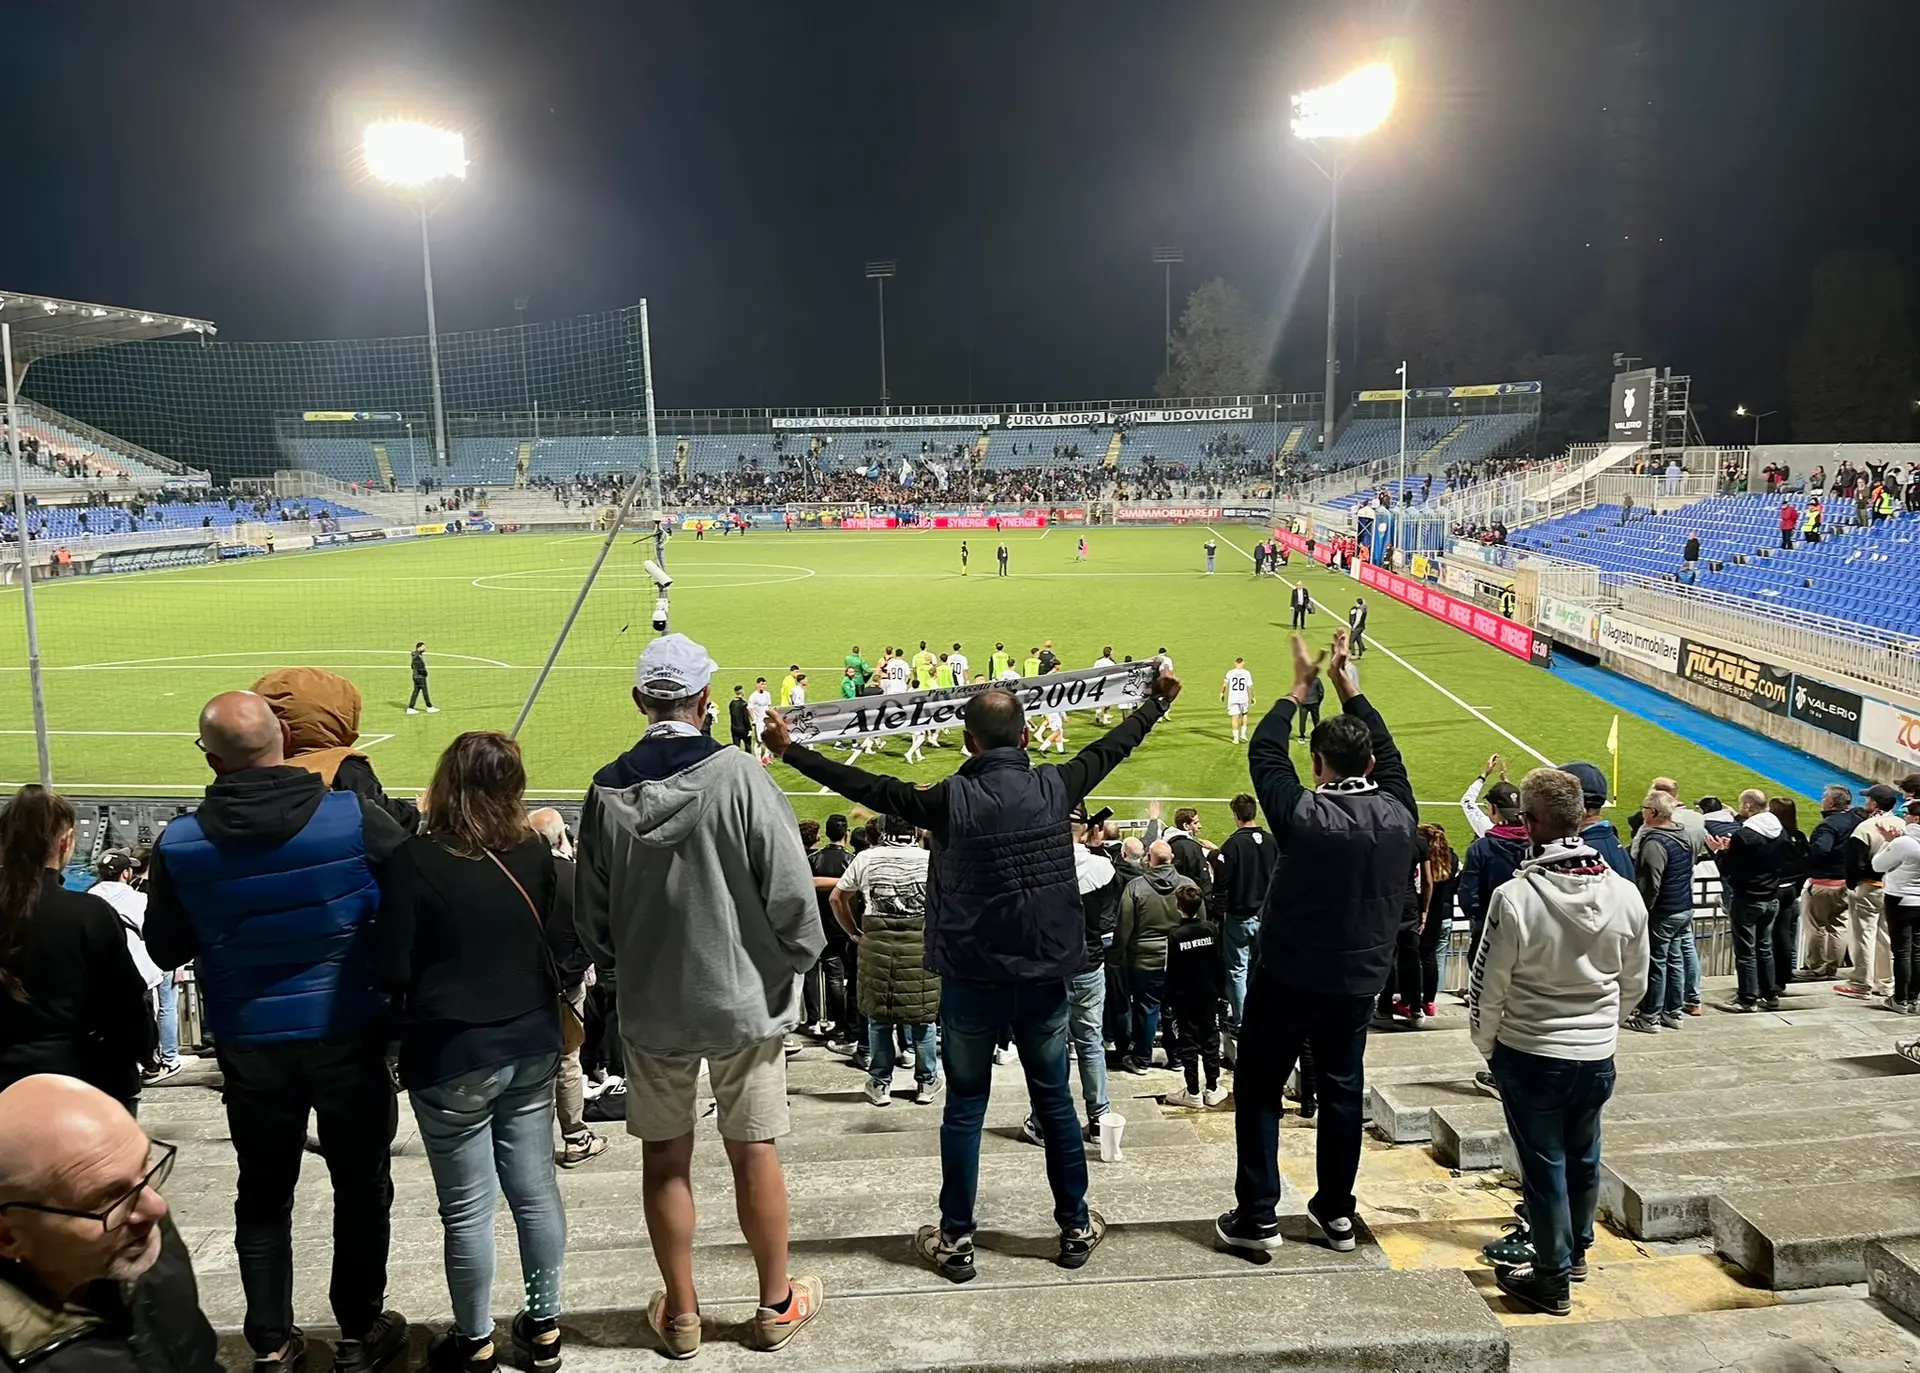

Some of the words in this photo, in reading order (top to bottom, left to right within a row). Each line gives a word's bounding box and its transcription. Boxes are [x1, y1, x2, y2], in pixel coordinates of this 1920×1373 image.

[776, 418, 820, 428] FORZA
[824, 417, 880, 427] VECCHIO
[884, 416, 929, 426] CUORE
[932, 415, 996, 425] AZZURRO
[1059, 413, 1101, 424] NORD
[1162, 409, 1250, 421] UDOVICICH
[847, 518, 888, 528] SYNERGIE
[948, 517, 989, 528] SYNERGIE
[1634, 630, 1678, 660] Immobiliare
[928, 689, 947, 697] Pro
[950, 682, 990, 694] Vercelli
[994, 680, 1019, 689] Club
[1232, 677, 1245, 691] 26
[1025, 676, 1107, 712] 2004
[1807, 696, 1858, 721] VALERIO
